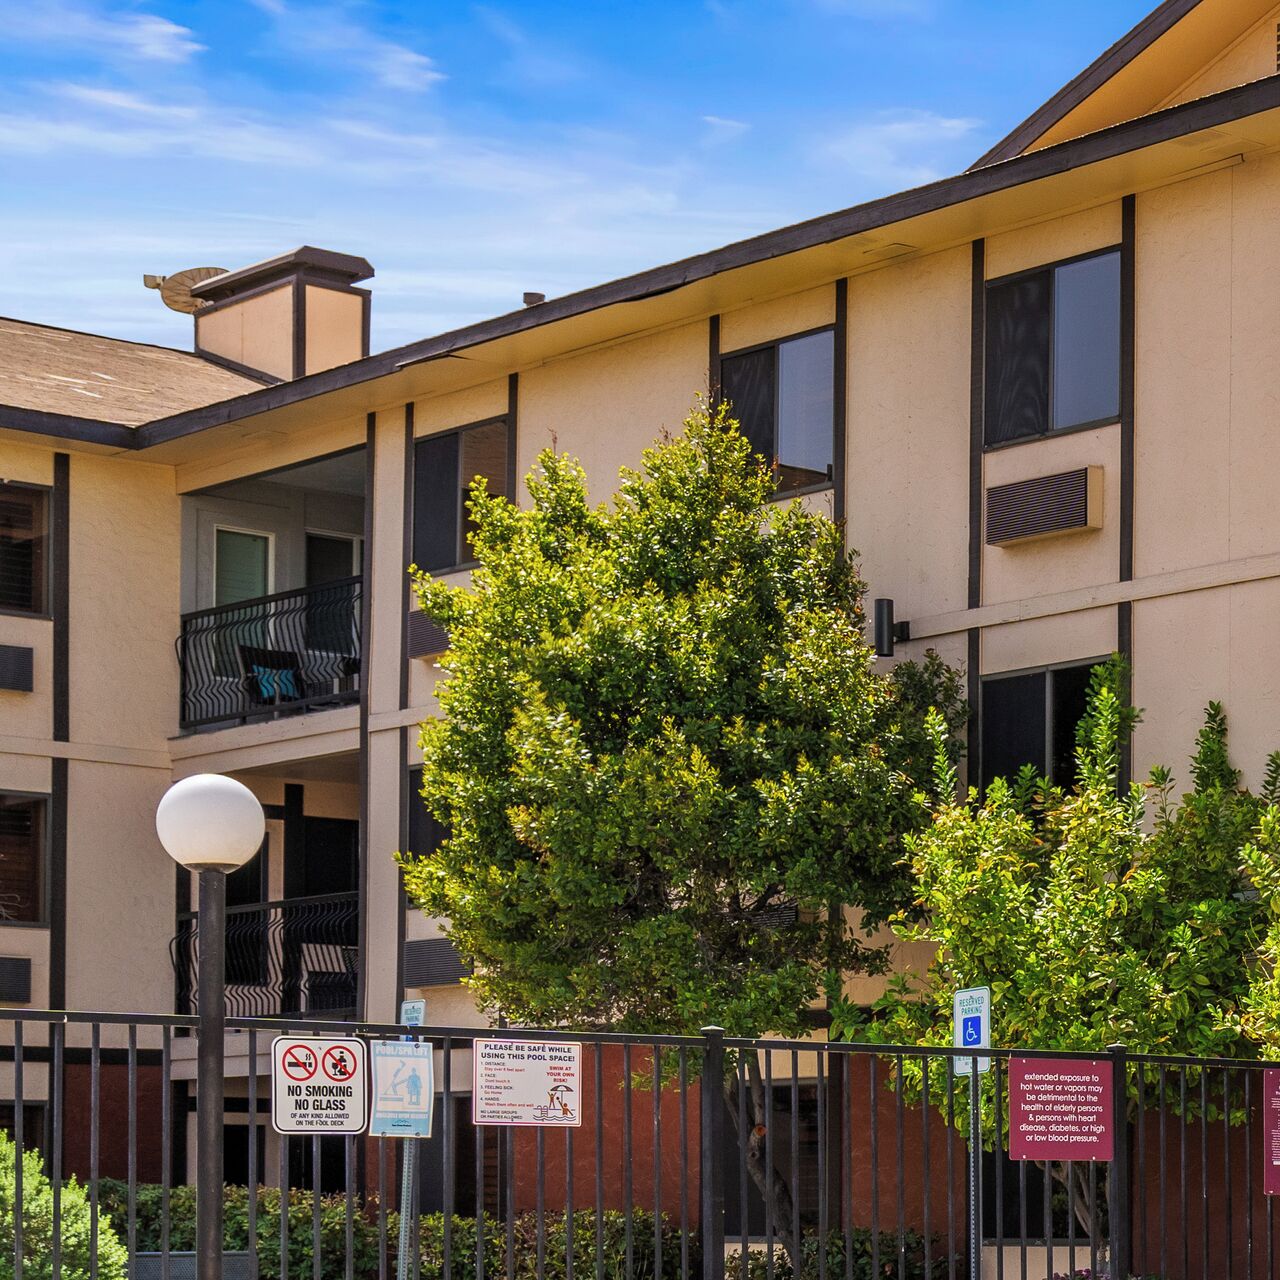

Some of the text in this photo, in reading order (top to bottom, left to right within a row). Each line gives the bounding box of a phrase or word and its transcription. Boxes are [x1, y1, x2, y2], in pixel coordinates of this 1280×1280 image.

[288, 1086, 352, 1097] NO SMOKING
[295, 1100, 345, 1110] NO GLASS
[1054, 1104, 1076, 1113] elderly
[1090, 1125, 1105, 1133] high
